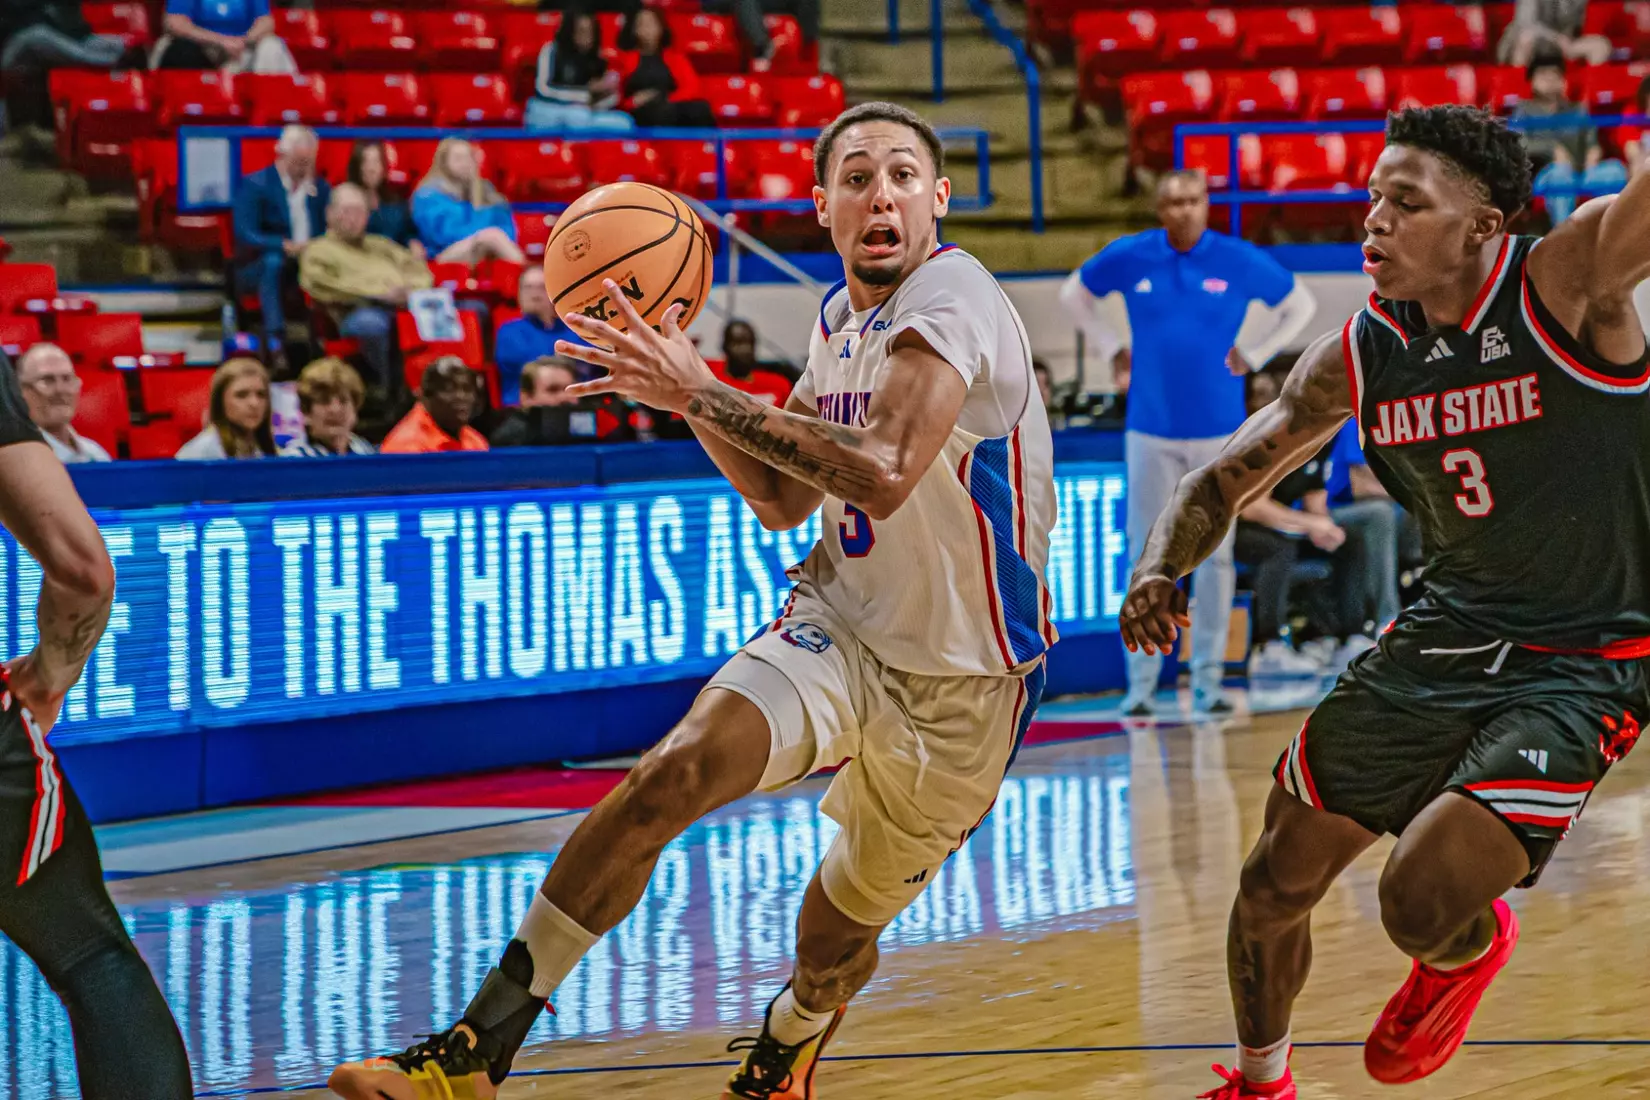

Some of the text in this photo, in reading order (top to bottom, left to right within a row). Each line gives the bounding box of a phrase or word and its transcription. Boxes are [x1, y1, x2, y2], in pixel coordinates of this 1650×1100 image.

[1480, 342, 1512, 364] USA
[1370, 372, 1543, 445] JAX STATE
[1441, 447, 1495, 518] 3
[157, 516, 250, 710] TO
[272, 511, 402, 699] THE
[419, 494, 686, 684] THOMAS
